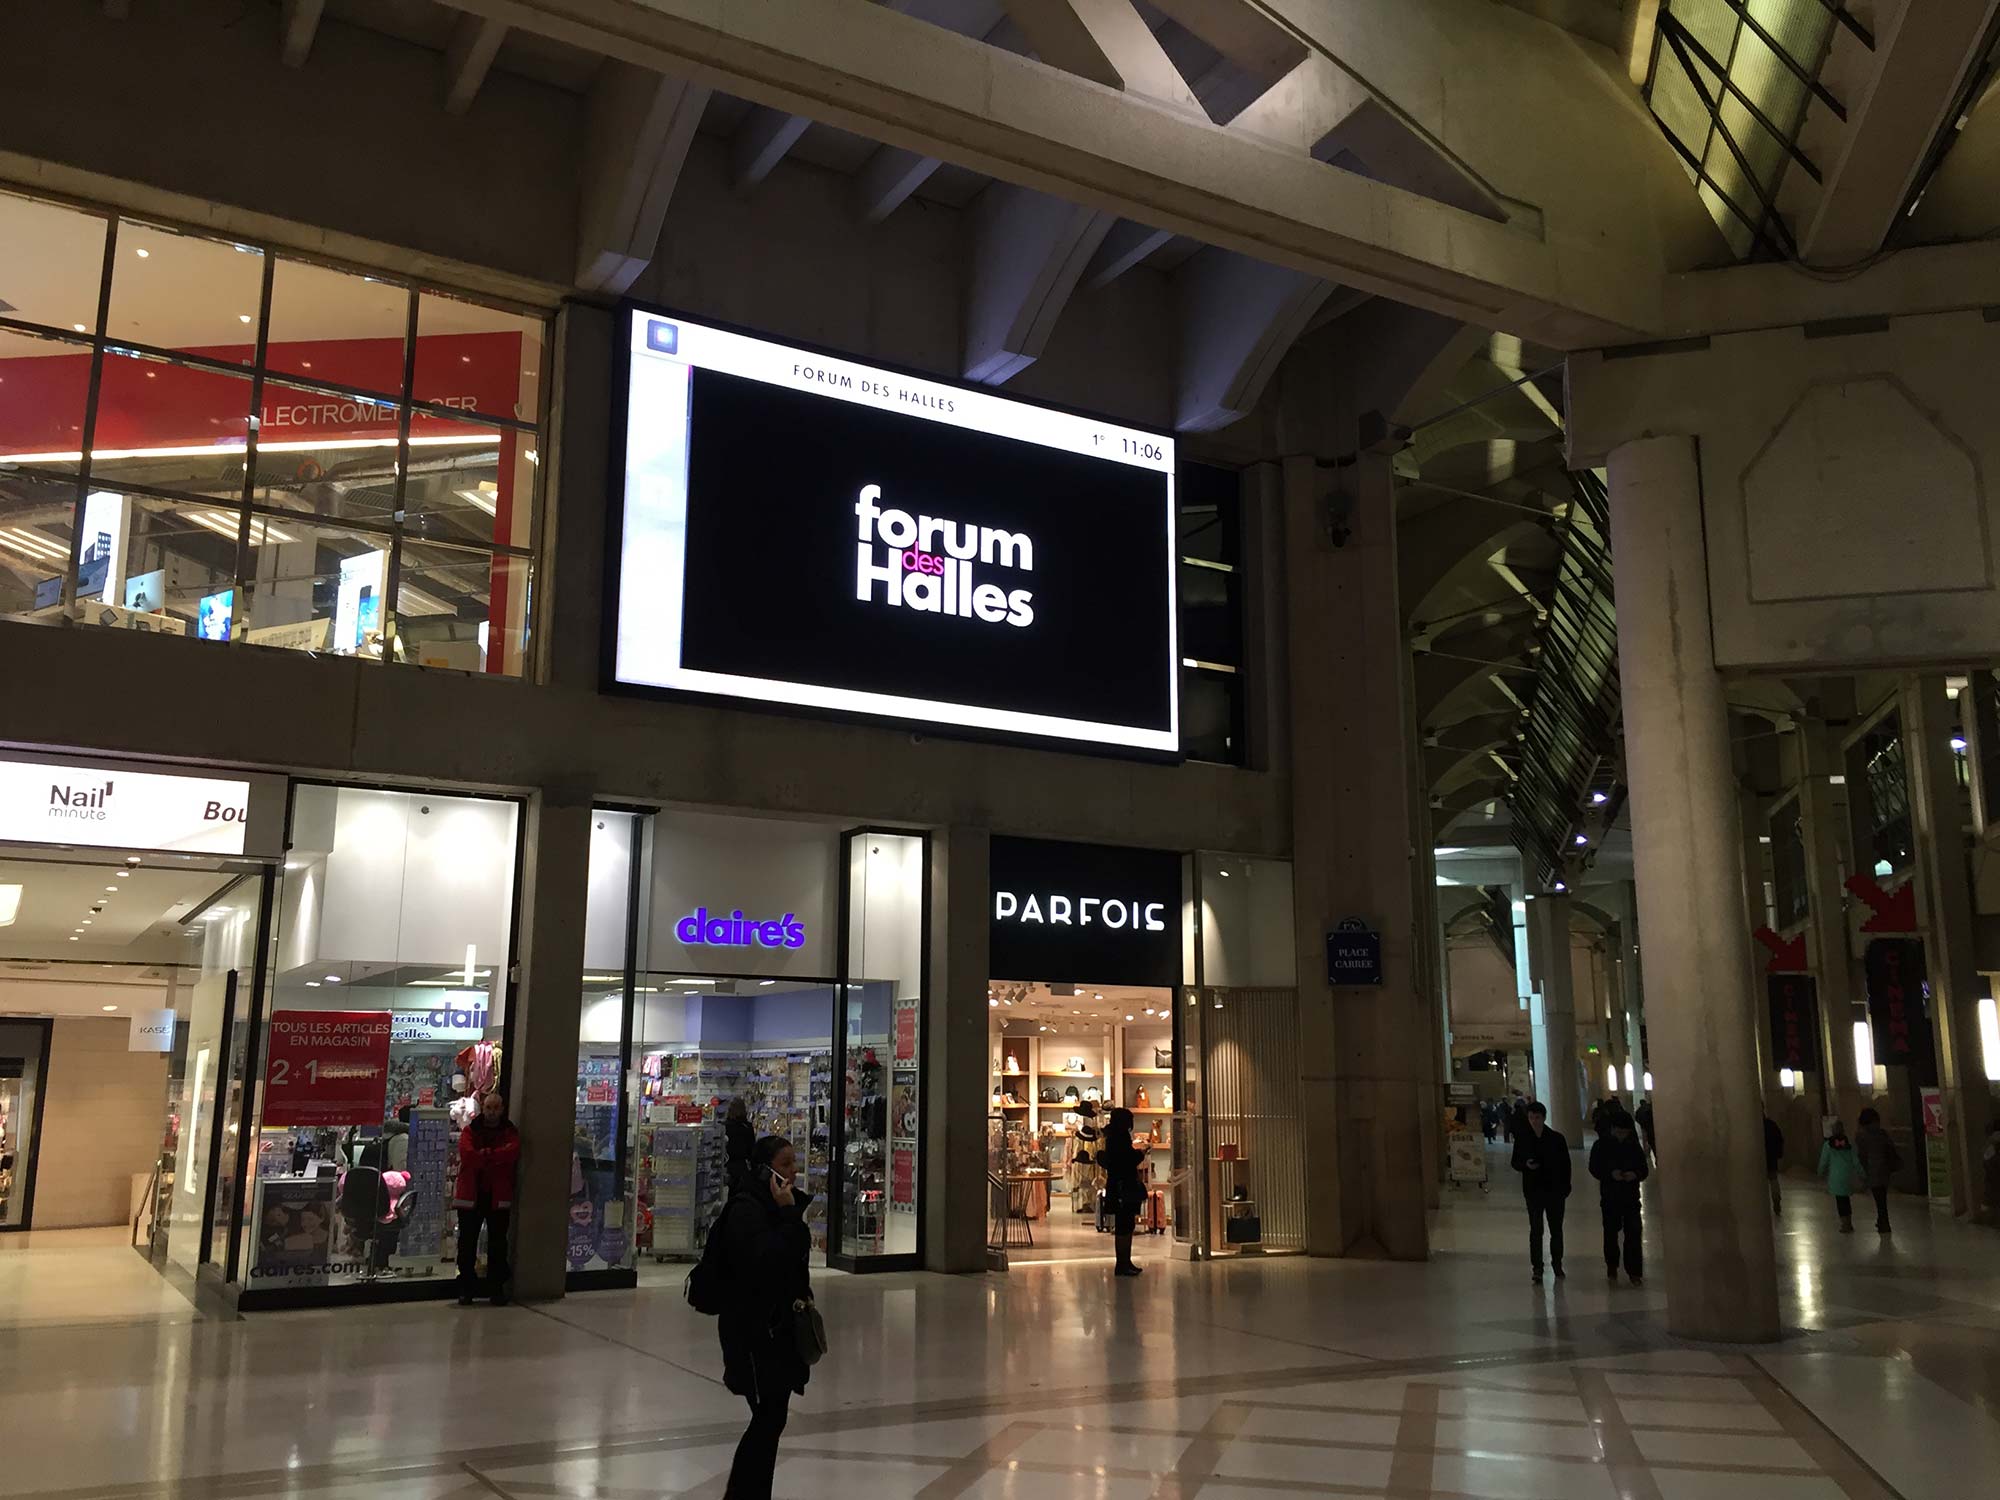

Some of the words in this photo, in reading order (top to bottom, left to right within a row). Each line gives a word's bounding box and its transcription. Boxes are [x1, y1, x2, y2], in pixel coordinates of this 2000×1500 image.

[794, 365, 852, 389] FORUM
[862, 381, 890, 398] DES
[899, 389, 955, 413] HALLES
[1122, 438, 1162, 461] 11:06
[855, 484, 1033, 571] forum
[902, 540, 944, 575] des
[857, 541, 1034, 627] Halles
[50, 784, 106, 808] Nail
[49, 808, 107, 821] minute
[996, 891, 1165, 931] PARFOIS
[675, 906, 806, 950] claire's
[1338, 947, 1369, 958] PLACE
[272, 1022, 307, 1033] TOUS
[310, 1023, 331, 1034] LES
[333, 1023, 390, 1035] ARTICLES
[290, 1035, 309, 1046] EN
[311, 1036, 371, 1047] MAGASIN
[250, 1261, 360, 1279] claires.com
